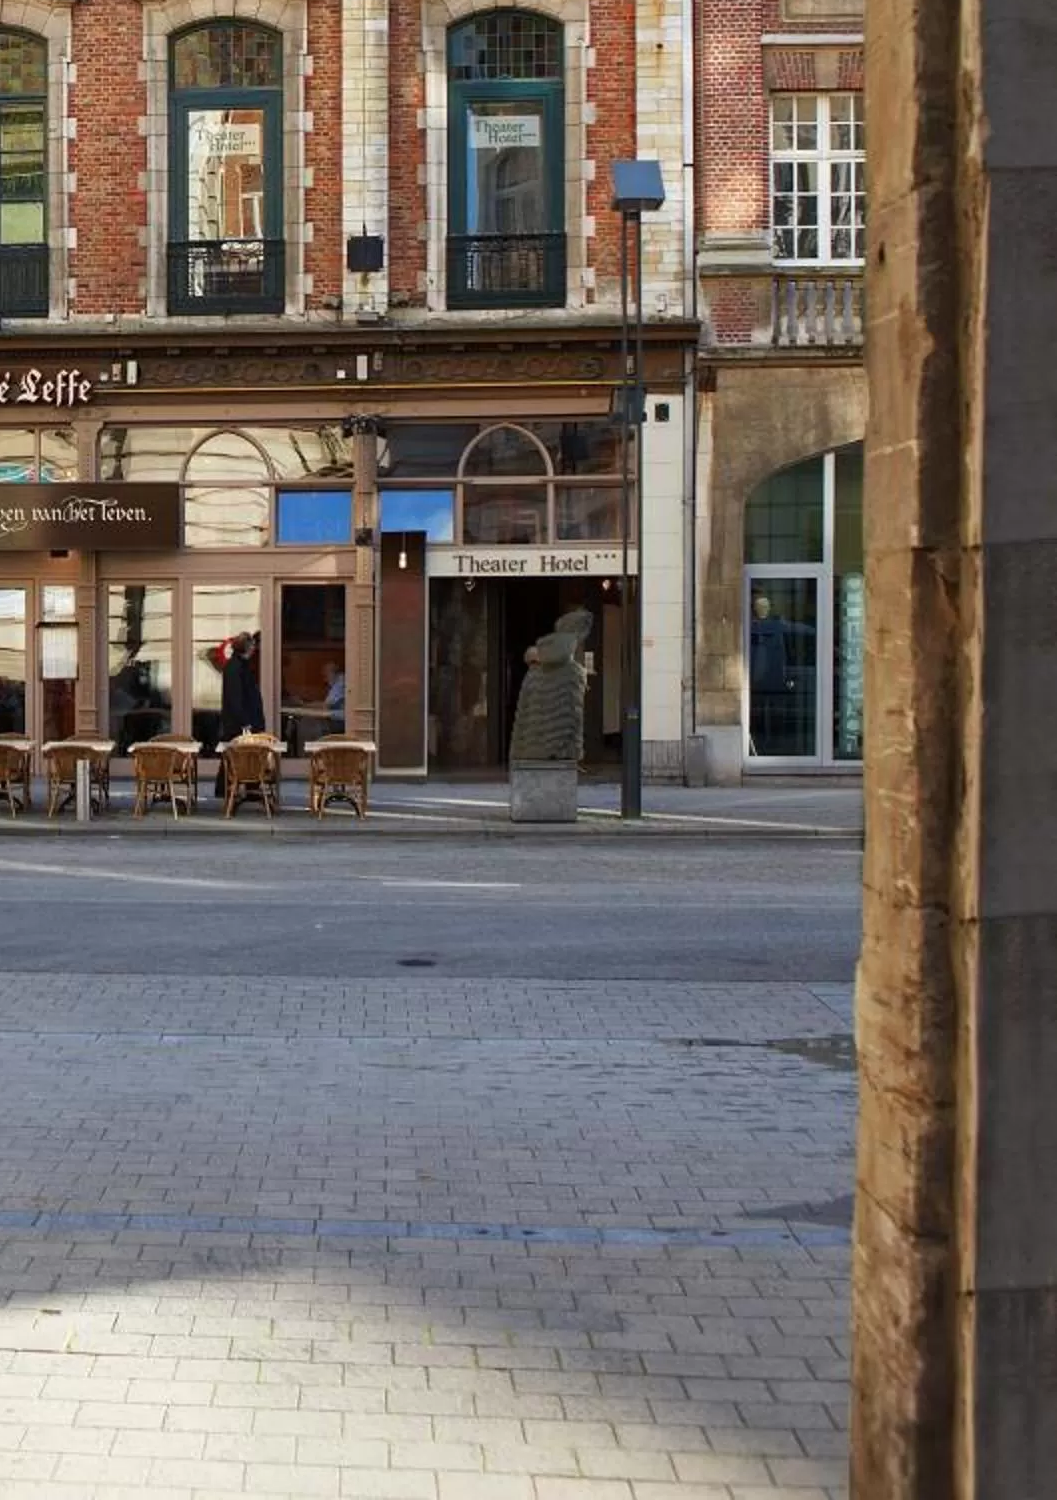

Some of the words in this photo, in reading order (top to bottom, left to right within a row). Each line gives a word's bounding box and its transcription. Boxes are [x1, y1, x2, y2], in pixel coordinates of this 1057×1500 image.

[475, 120, 525, 132] Theater
[196, 129, 246, 141] Theater
[488, 128, 522, 143] Hotel
[210, 140, 244, 151] Hotel
[17, 368, 92, 407] Leffe
[32, 507, 64, 521] van
[65, 502, 95, 522] het
[453, 555, 528, 573] Theater
[540, 554, 590, 573] Hotel
